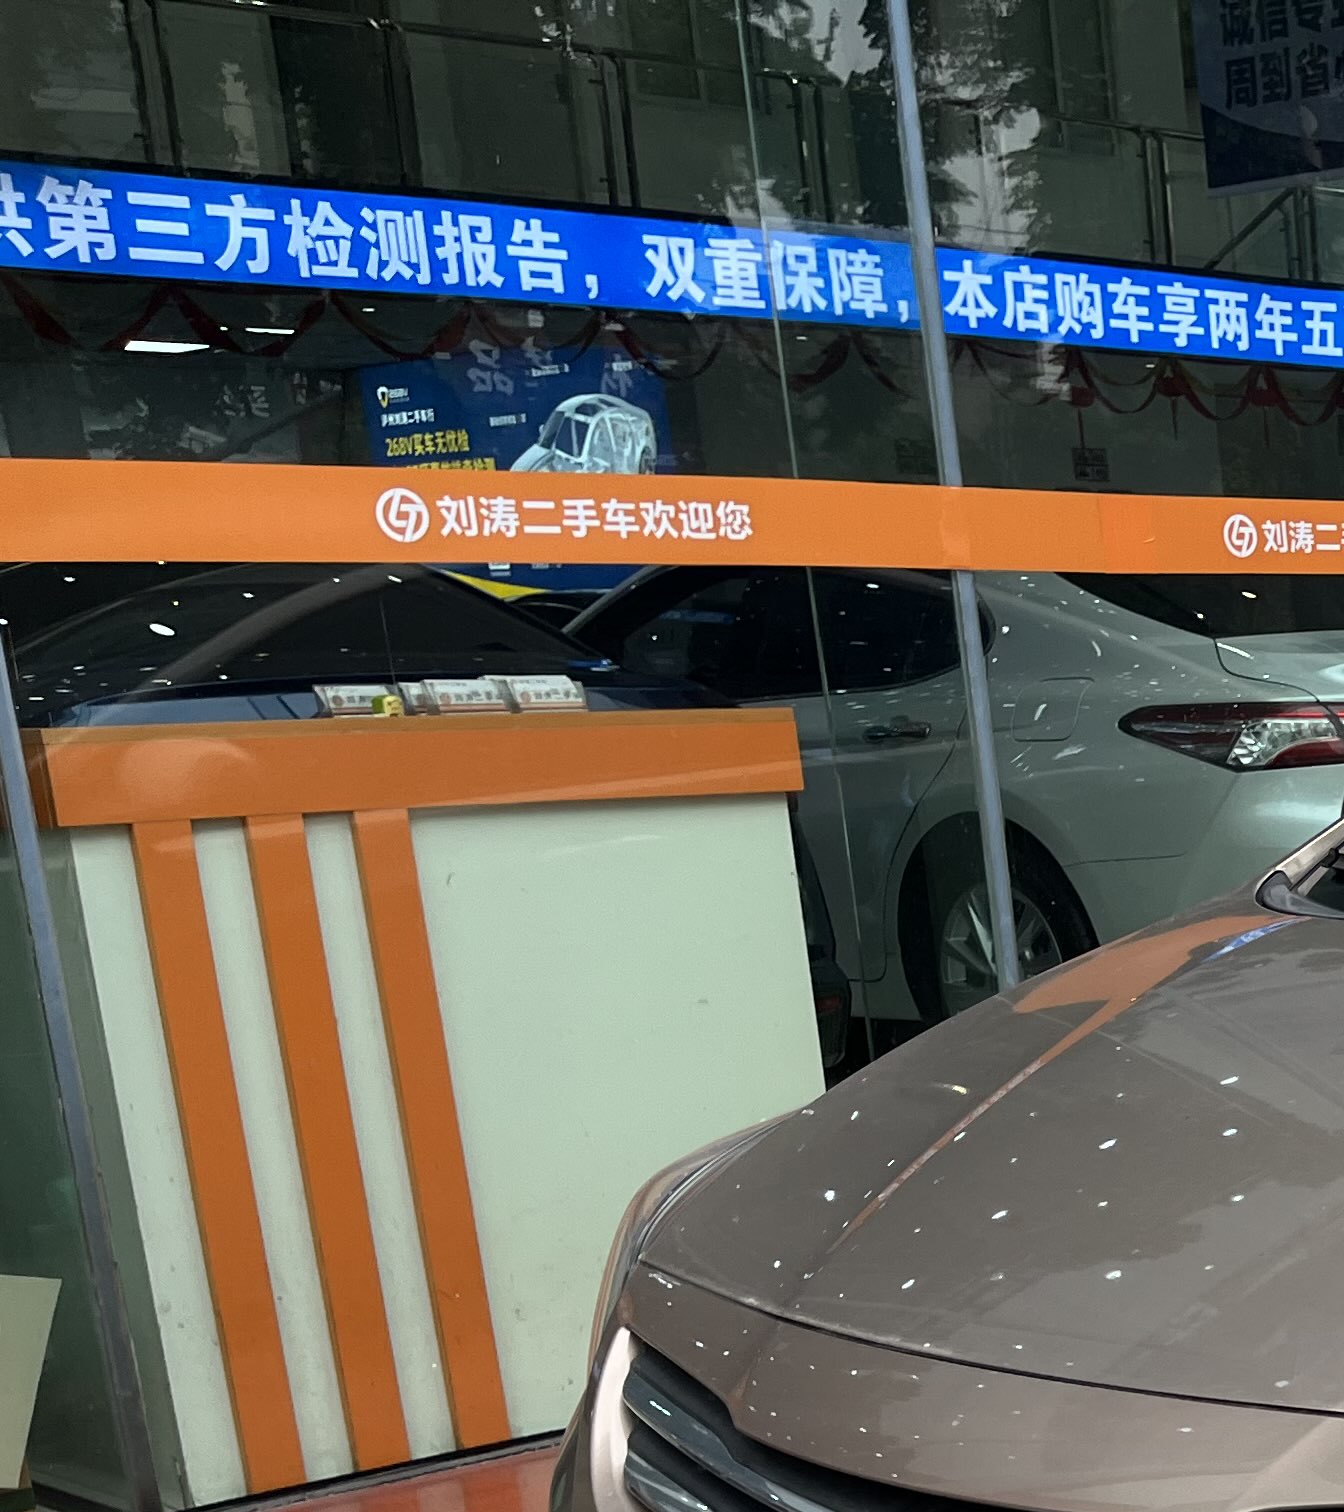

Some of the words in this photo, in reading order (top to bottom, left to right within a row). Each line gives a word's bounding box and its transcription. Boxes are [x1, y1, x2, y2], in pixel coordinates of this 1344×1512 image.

[435, 494, 754, 542] 刘涛二手车欢迎您
